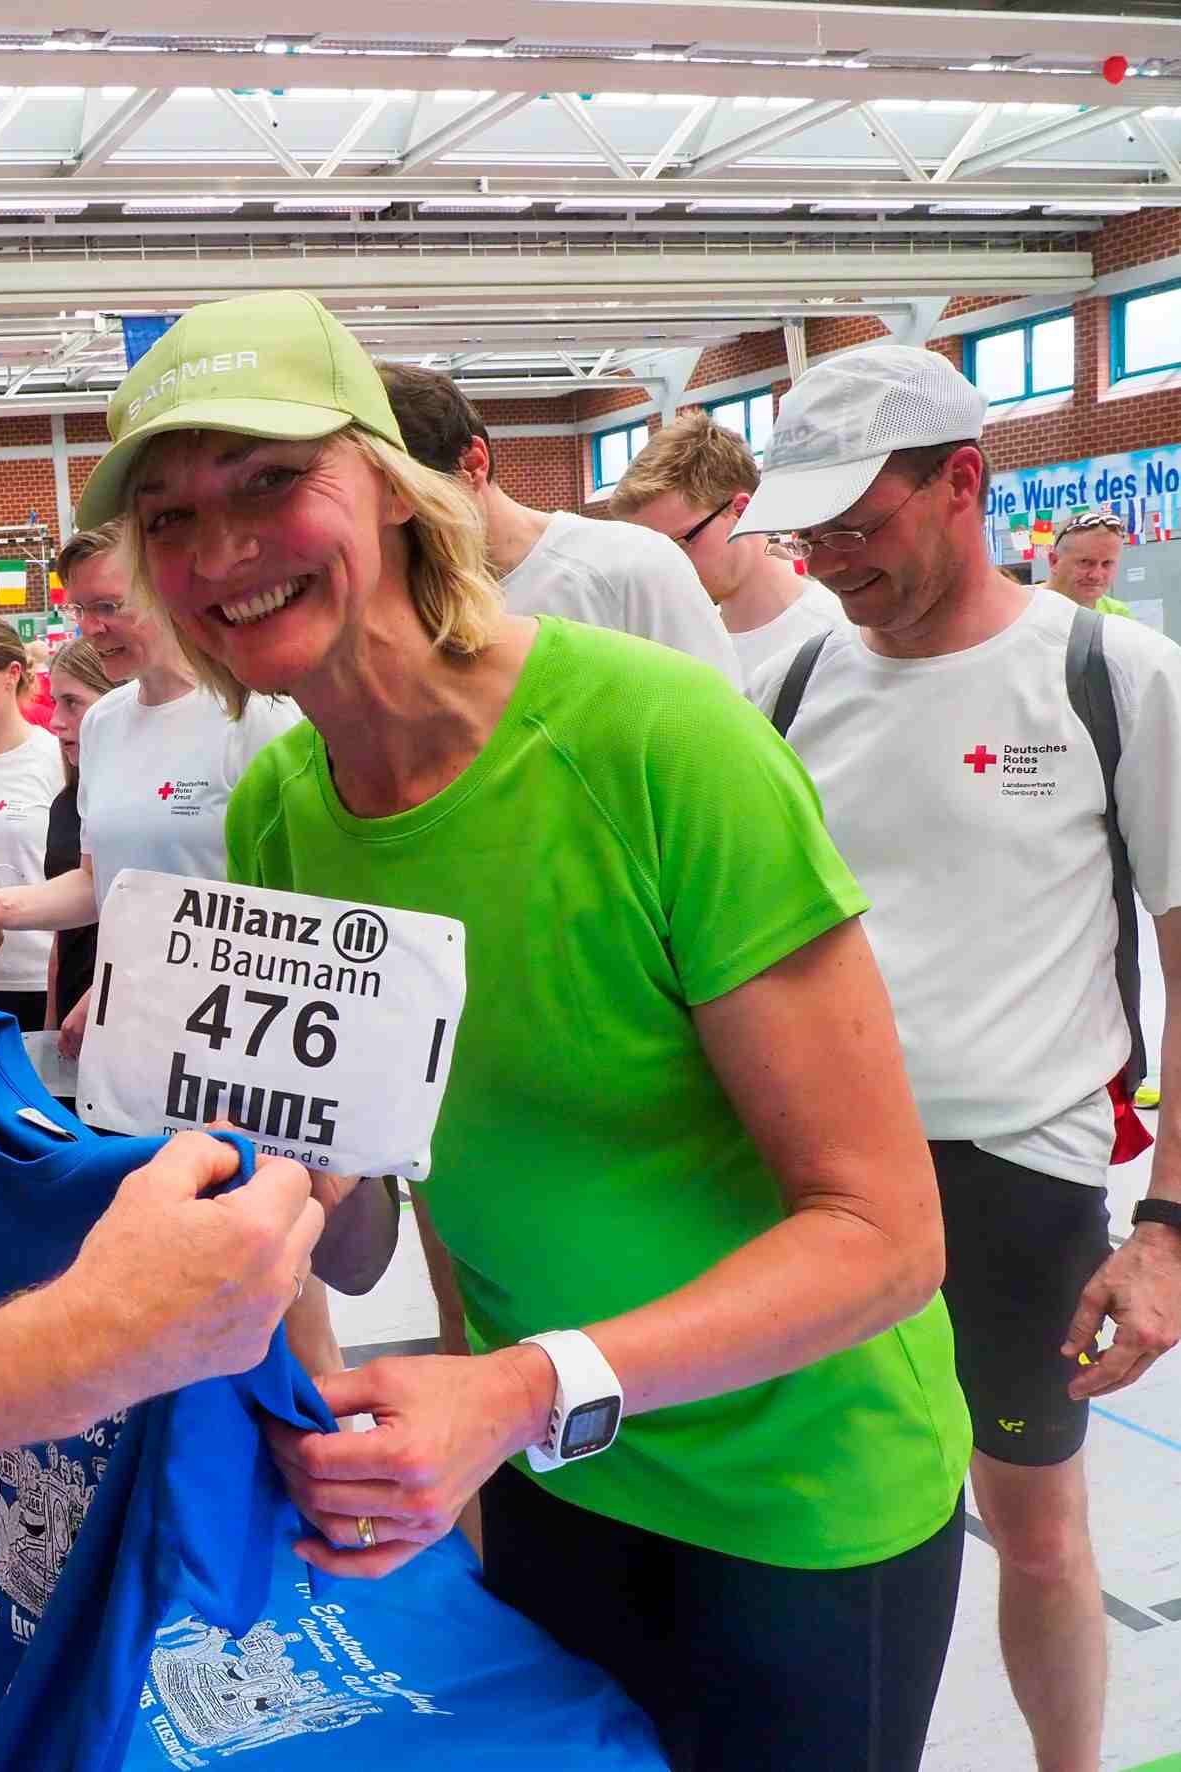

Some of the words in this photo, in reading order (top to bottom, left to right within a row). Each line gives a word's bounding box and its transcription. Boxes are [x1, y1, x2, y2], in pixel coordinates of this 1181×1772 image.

[1023, 471, 1087, 512] Wurst
[1095, 468, 1137, 505] des
[1002, 764, 1038, 774] Kreuz
[1003, 744, 1068, 754] Deutsches
[1003, 754, 1038, 764] Rotes
[172, 888, 322, 947] Allianz
[166, 930, 199, 969] D.
[210, 937, 382, 998] Baumann
[185, 984, 340, 1068] 476
[165, 1051, 339, 1146] bruns
